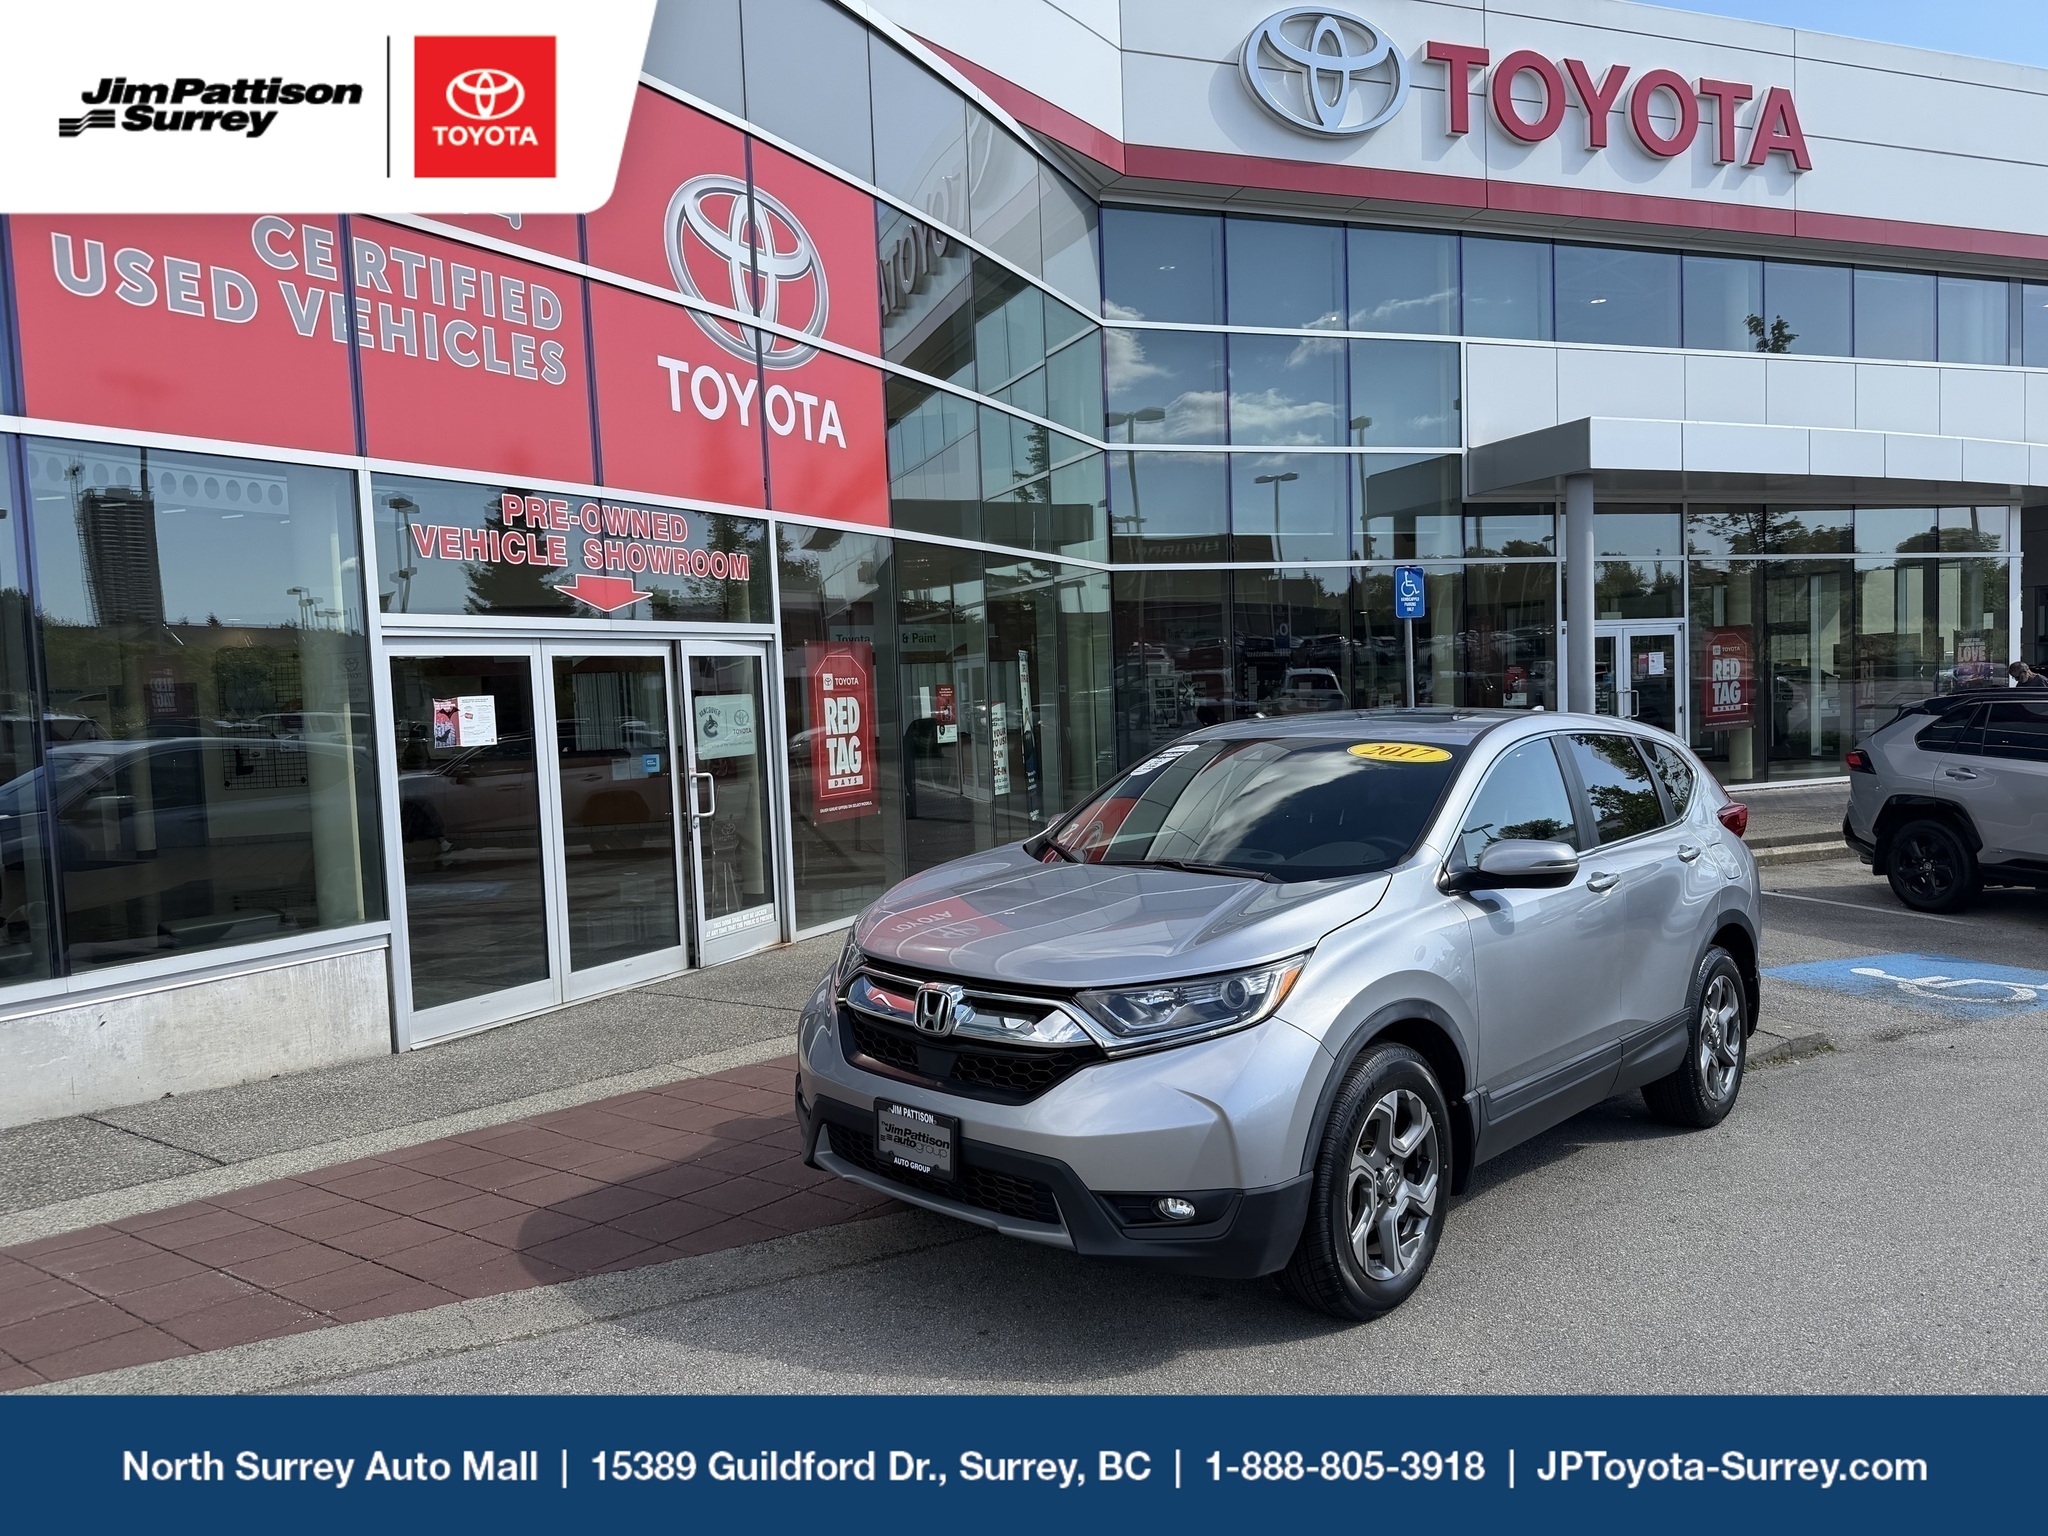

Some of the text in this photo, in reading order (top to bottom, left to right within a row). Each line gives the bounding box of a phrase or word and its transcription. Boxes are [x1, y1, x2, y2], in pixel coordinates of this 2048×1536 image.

[1422, 41, 1813, 174] TOYOTA
[251, 215, 563, 331] CERTIFIED
[50, 231, 567, 386] USED VEHICLES
[657, 355, 848, 449] TOYOTA
[501, 493, 689, 544] PRE-OWNED
[411, 523, 750, 582] VEHICLE SHOWROOM
[913, 633, 937, 643] Paint
[1957, 646, 1987, 662] LOVE
[835, 677, 859, 685] TOYOTA
[1712, 657, 1741, 682] RED
[1712, 681, 1741, 705] TAG
[823, 696, 860, 735] RED
[732, 727, 752, 735] TOYOTA
[826, 735, 862, 776] TAG
[1360, 745, 1437, 759] 2017
[834, 778, 858, 787] DAYS
[890, 1104, 934, 1125] JIM PATTISON
[893, 1156, 931, 1173] AUTO GROUP
